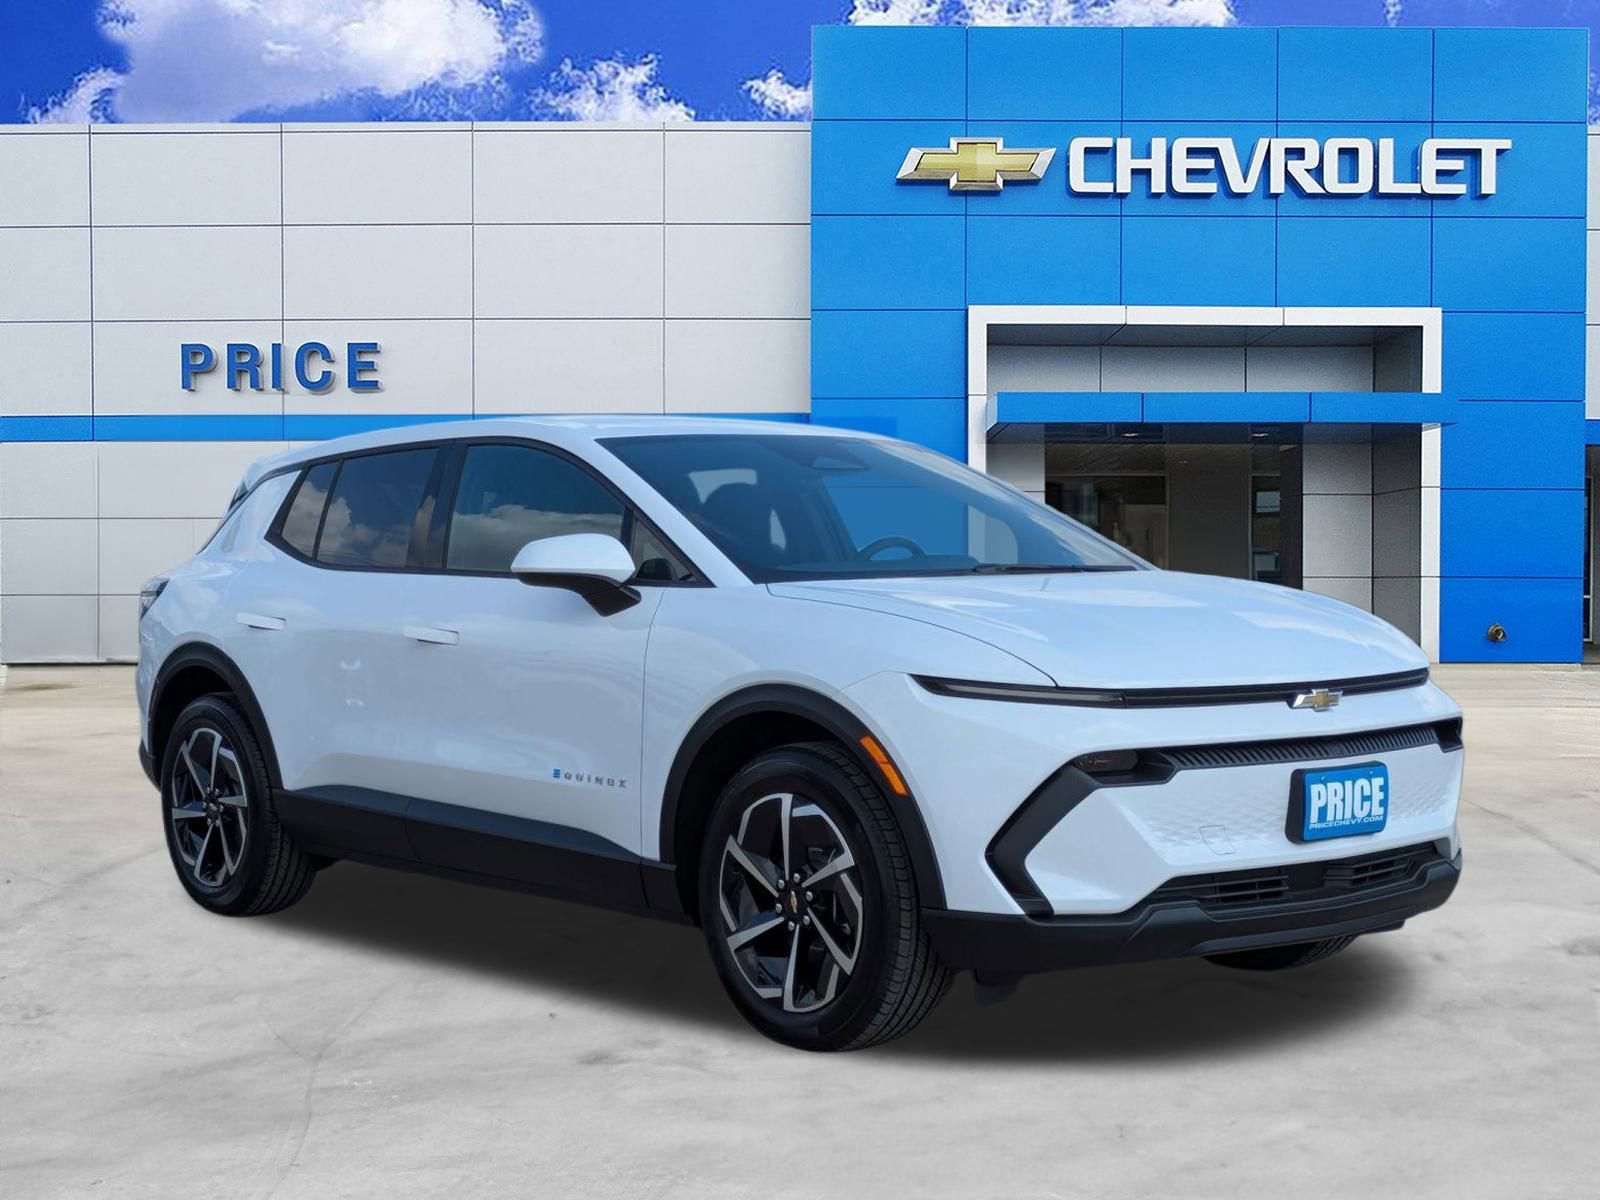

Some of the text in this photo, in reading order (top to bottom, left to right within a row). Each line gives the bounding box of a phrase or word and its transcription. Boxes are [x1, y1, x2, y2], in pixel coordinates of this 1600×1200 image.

[1069, 136, 1513, 197] CHEVROLET
[180, 341, 382, 392] PRICE
[553, 768, 628, 789] EQUINOX
[1310, 777, 1385, 824] PRICE
[1308, 815, 1384, 830] PRICECHEVY.COM
